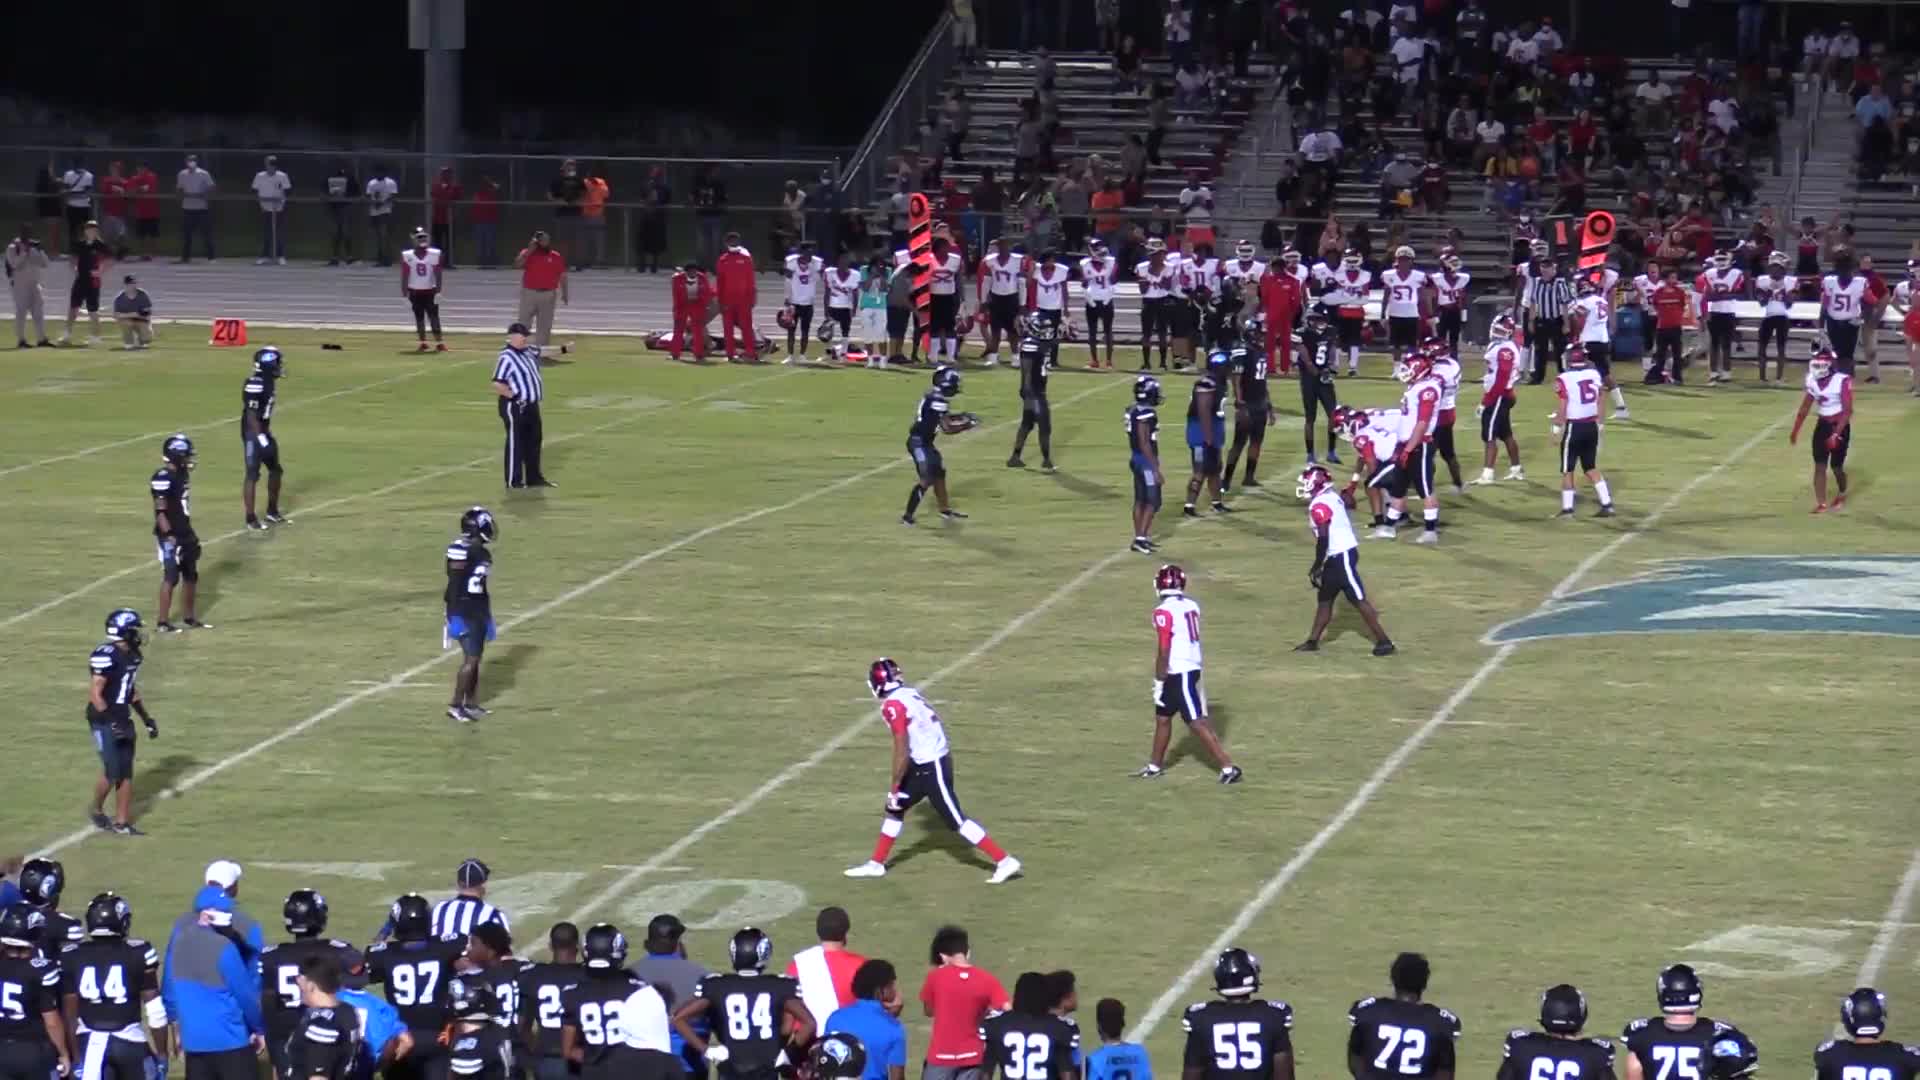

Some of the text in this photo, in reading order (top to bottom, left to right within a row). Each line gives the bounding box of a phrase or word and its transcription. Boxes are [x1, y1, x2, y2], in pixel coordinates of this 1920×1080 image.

[1834, 293, 1852, 313] 51
[213, 319, 240, 342] 20
[0, 982, 25, 1020] 5
[79, 964, 128, 1005] 44
[391, 960, 440, 1006] 97
[537, 984, 565, 1028] 2
[724, 993, 774, 1041] 84
[1003, 1031, 1051, 1080] 32
[1211, 1021, 1263, 1070] 55
[1373, 1023, 1427, 1074] 72
[1651, 1045, 1701, 1080] 75
